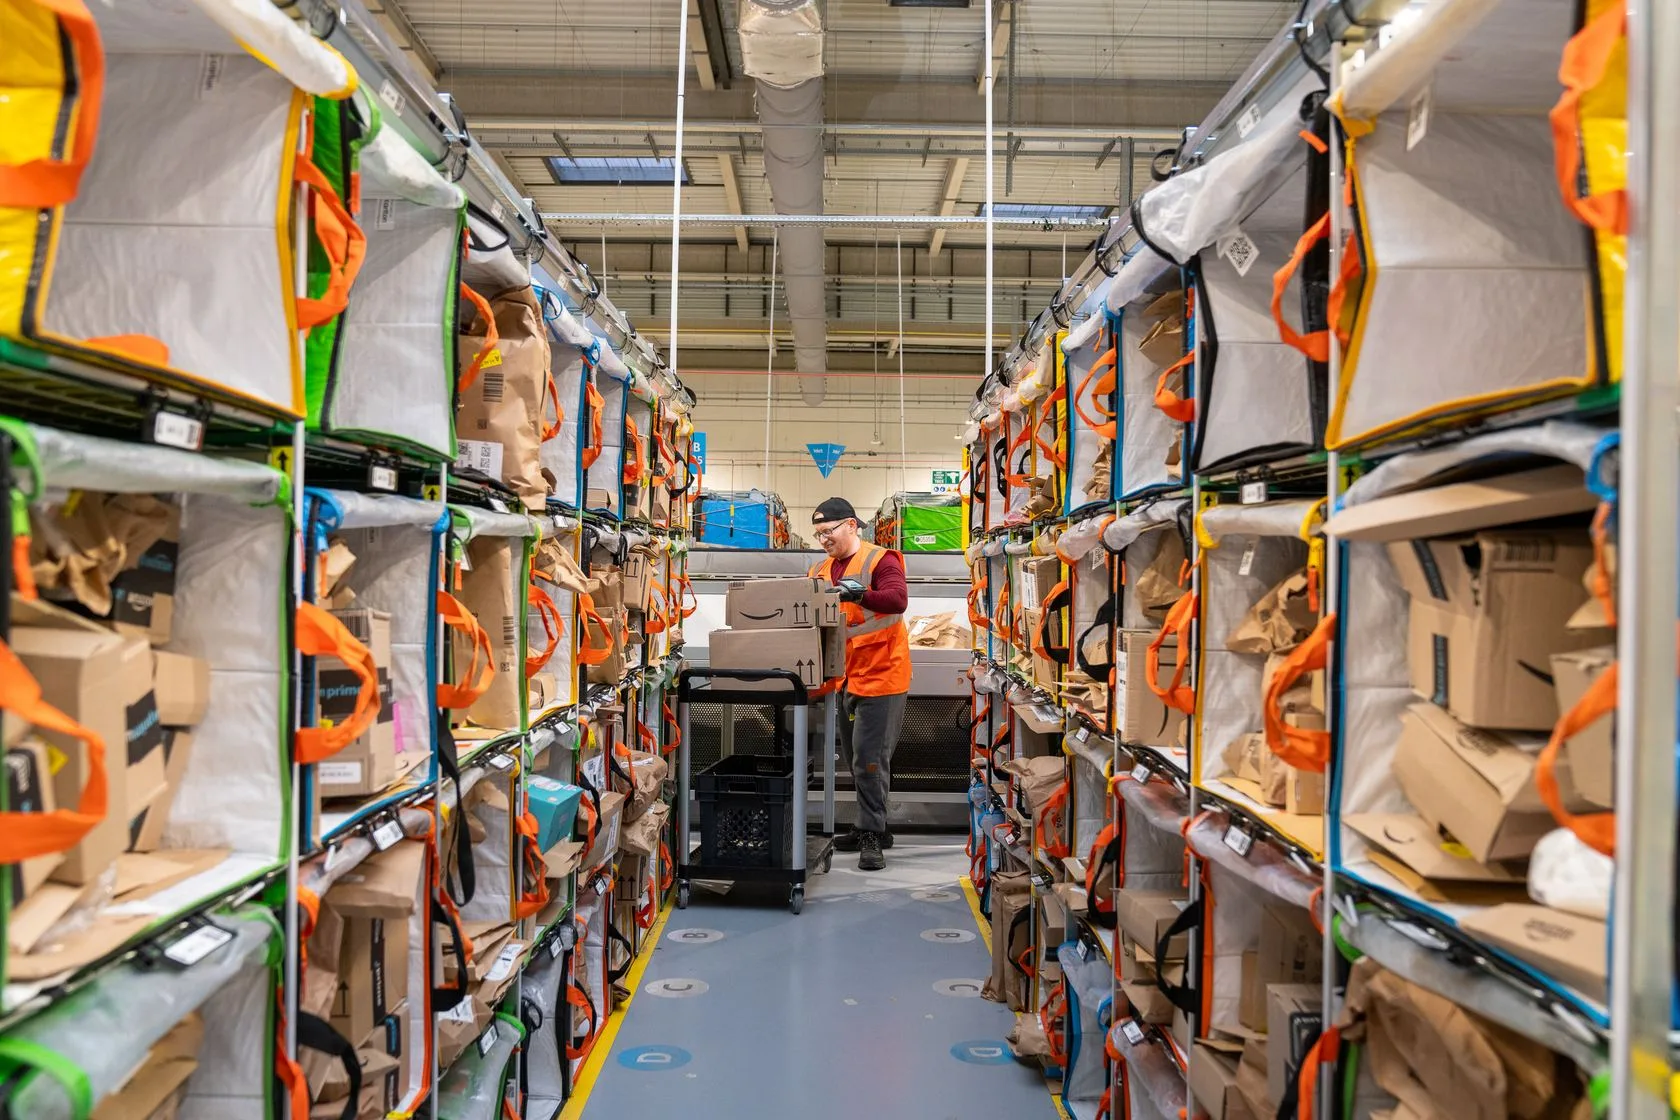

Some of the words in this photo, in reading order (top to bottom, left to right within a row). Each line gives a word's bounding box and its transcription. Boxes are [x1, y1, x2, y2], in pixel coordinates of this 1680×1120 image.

[693, 442, 701, 452] B
[663, 983, 693, 992] C
[949, 983, 979, 991] C
[636, 1052, 672, 1063] D
[969, 1047, 1002, 1058] D
